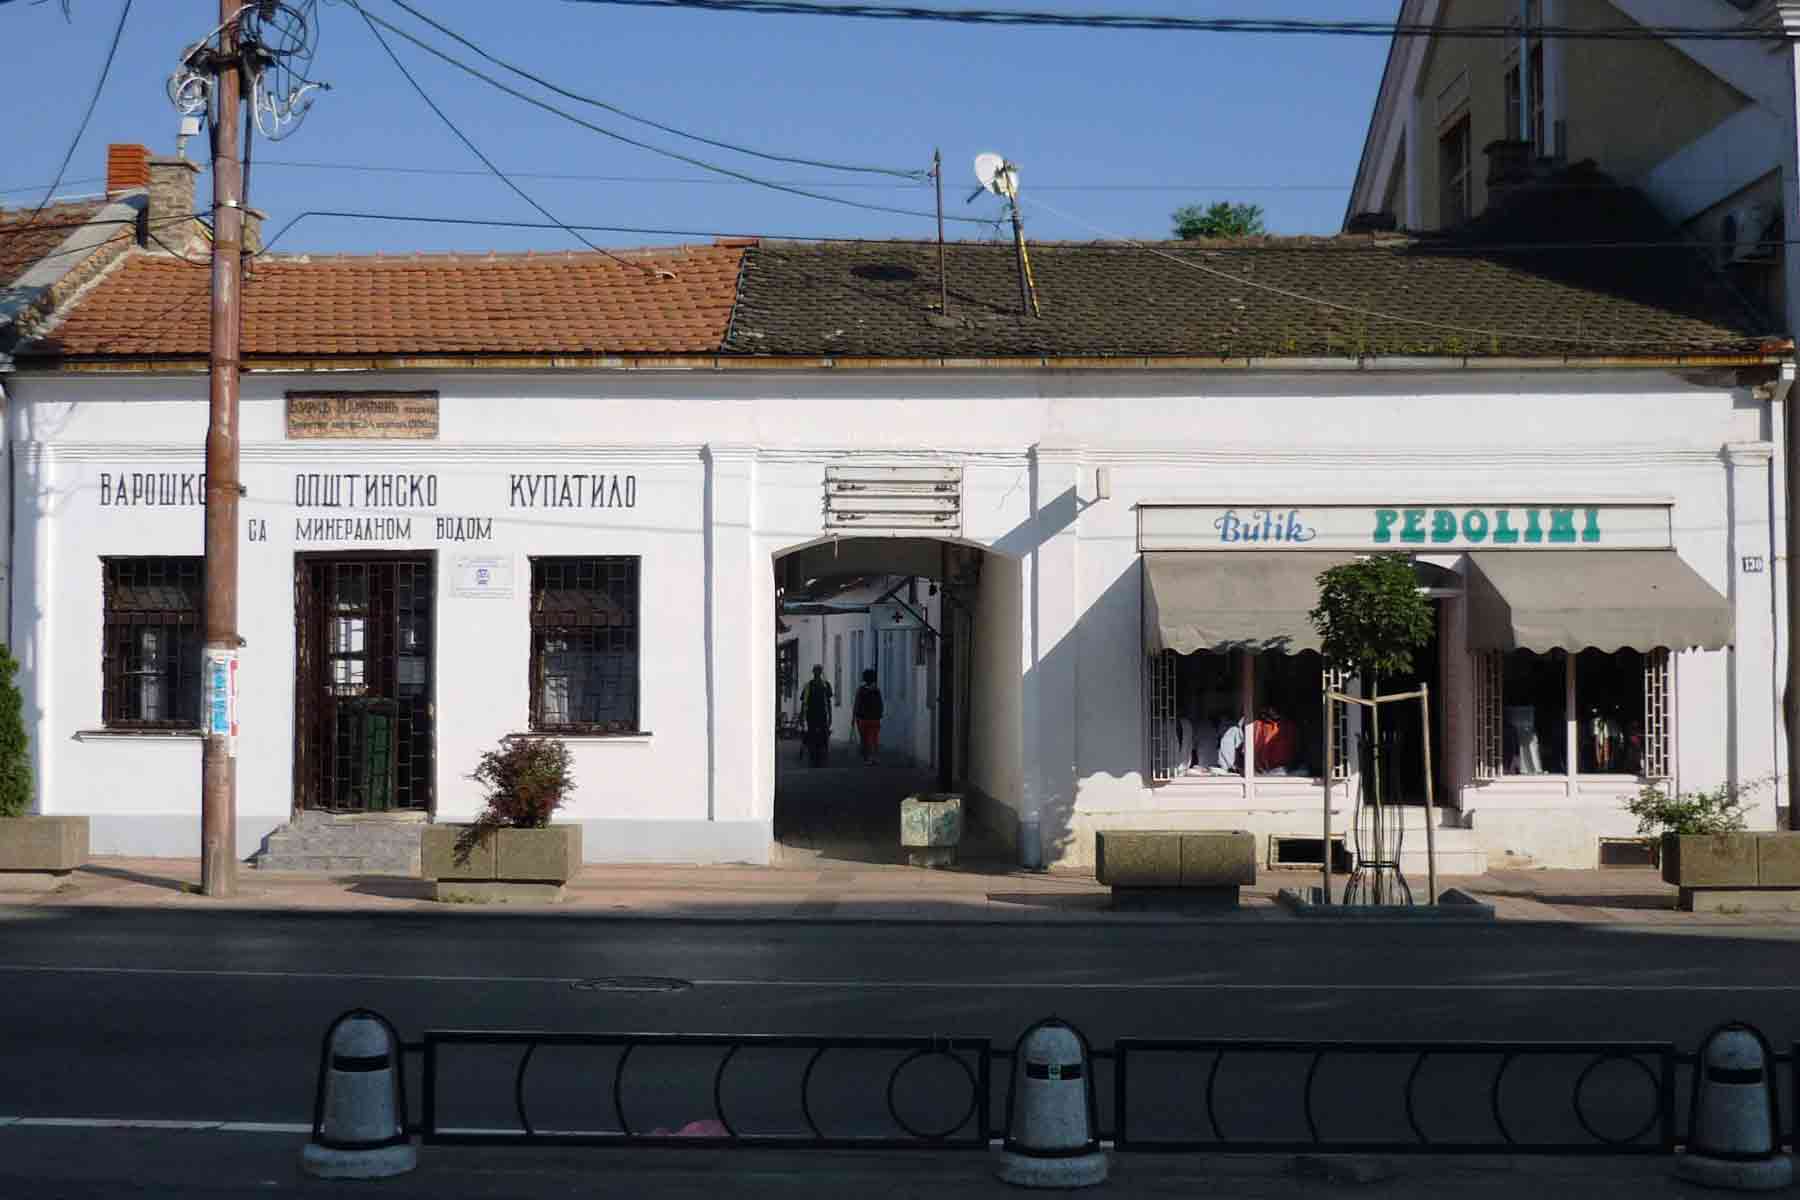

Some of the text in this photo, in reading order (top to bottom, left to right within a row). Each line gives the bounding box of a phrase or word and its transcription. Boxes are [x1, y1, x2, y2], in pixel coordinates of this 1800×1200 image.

[295, 474, 437, 507] ОПШТИНСКО
[509, 473, 636, 508] КУПАТИЛО
[248, 517, 493, 542] СА МИНЕРАЛНОМ ВОДОМ
[1214, 509, 1317, 543] Butik
